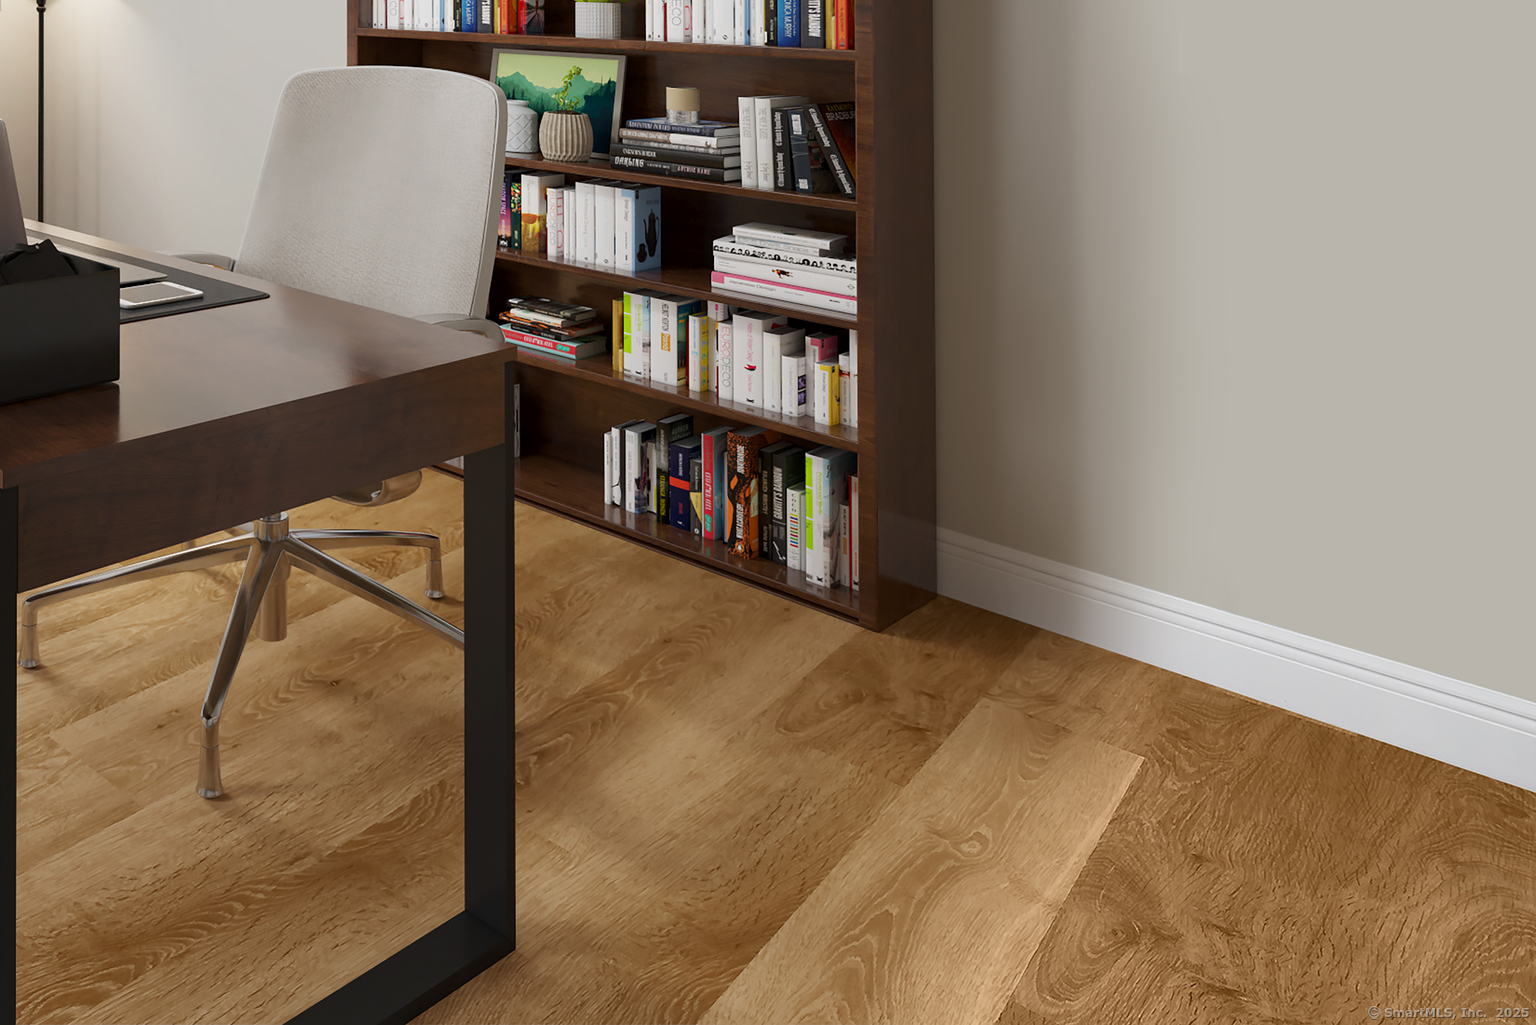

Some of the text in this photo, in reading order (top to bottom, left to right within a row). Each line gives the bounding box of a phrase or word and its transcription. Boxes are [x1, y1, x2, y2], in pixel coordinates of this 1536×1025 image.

[808, 14, 820, 37] RAINBOW
[826, 111, 855, 121] BRADBUR
[615, 157, 644, 168] DARLING
[728, 279, 776, 292] Japanese Design
[722, 326, 730, 387] EURODECO
[773, 466, 782, 519] GRAVITY'S RAINBOW
